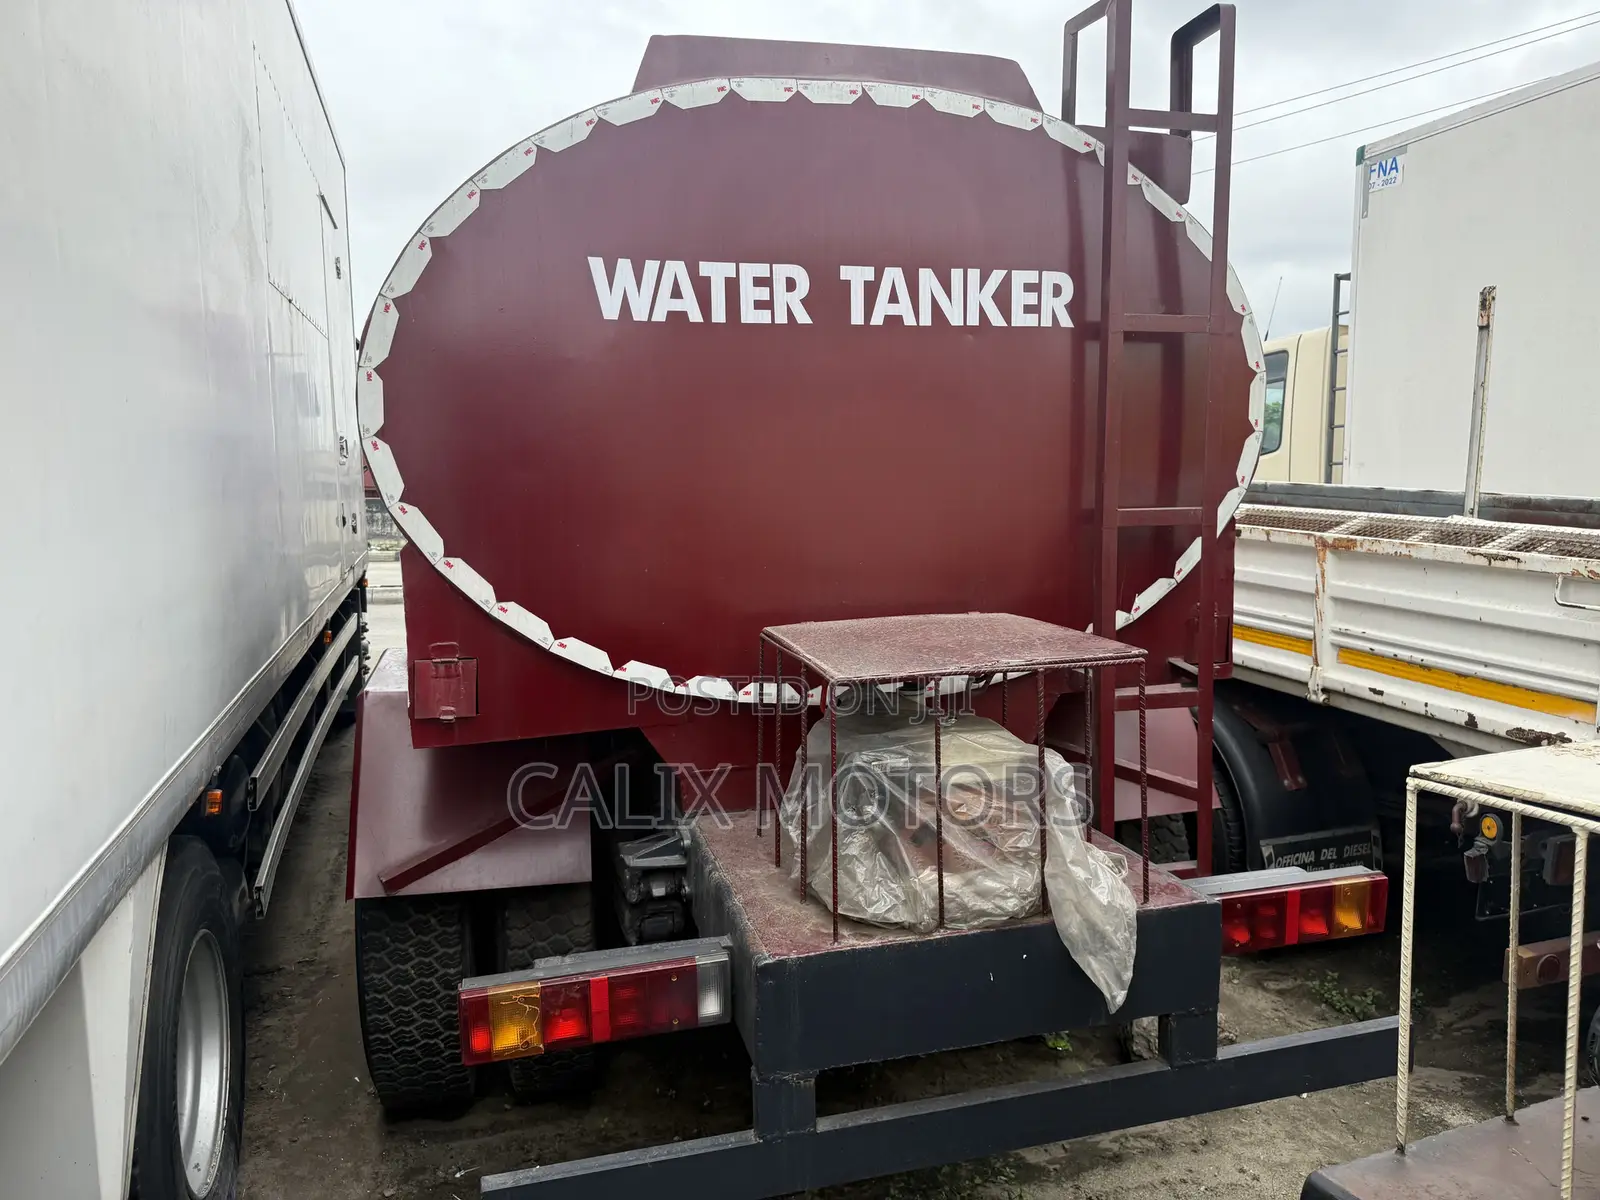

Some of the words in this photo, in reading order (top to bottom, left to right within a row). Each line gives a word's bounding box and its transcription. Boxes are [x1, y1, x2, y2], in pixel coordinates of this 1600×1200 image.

[587, 256, 813, 324] WATER
[840, 265, 1075, 328] TANKER
[1276, 850, 1315, 868] OFFICINA
[1320, 847, 1338, 861] DEL
[1343, 843, 1372, 858] DIESEL
